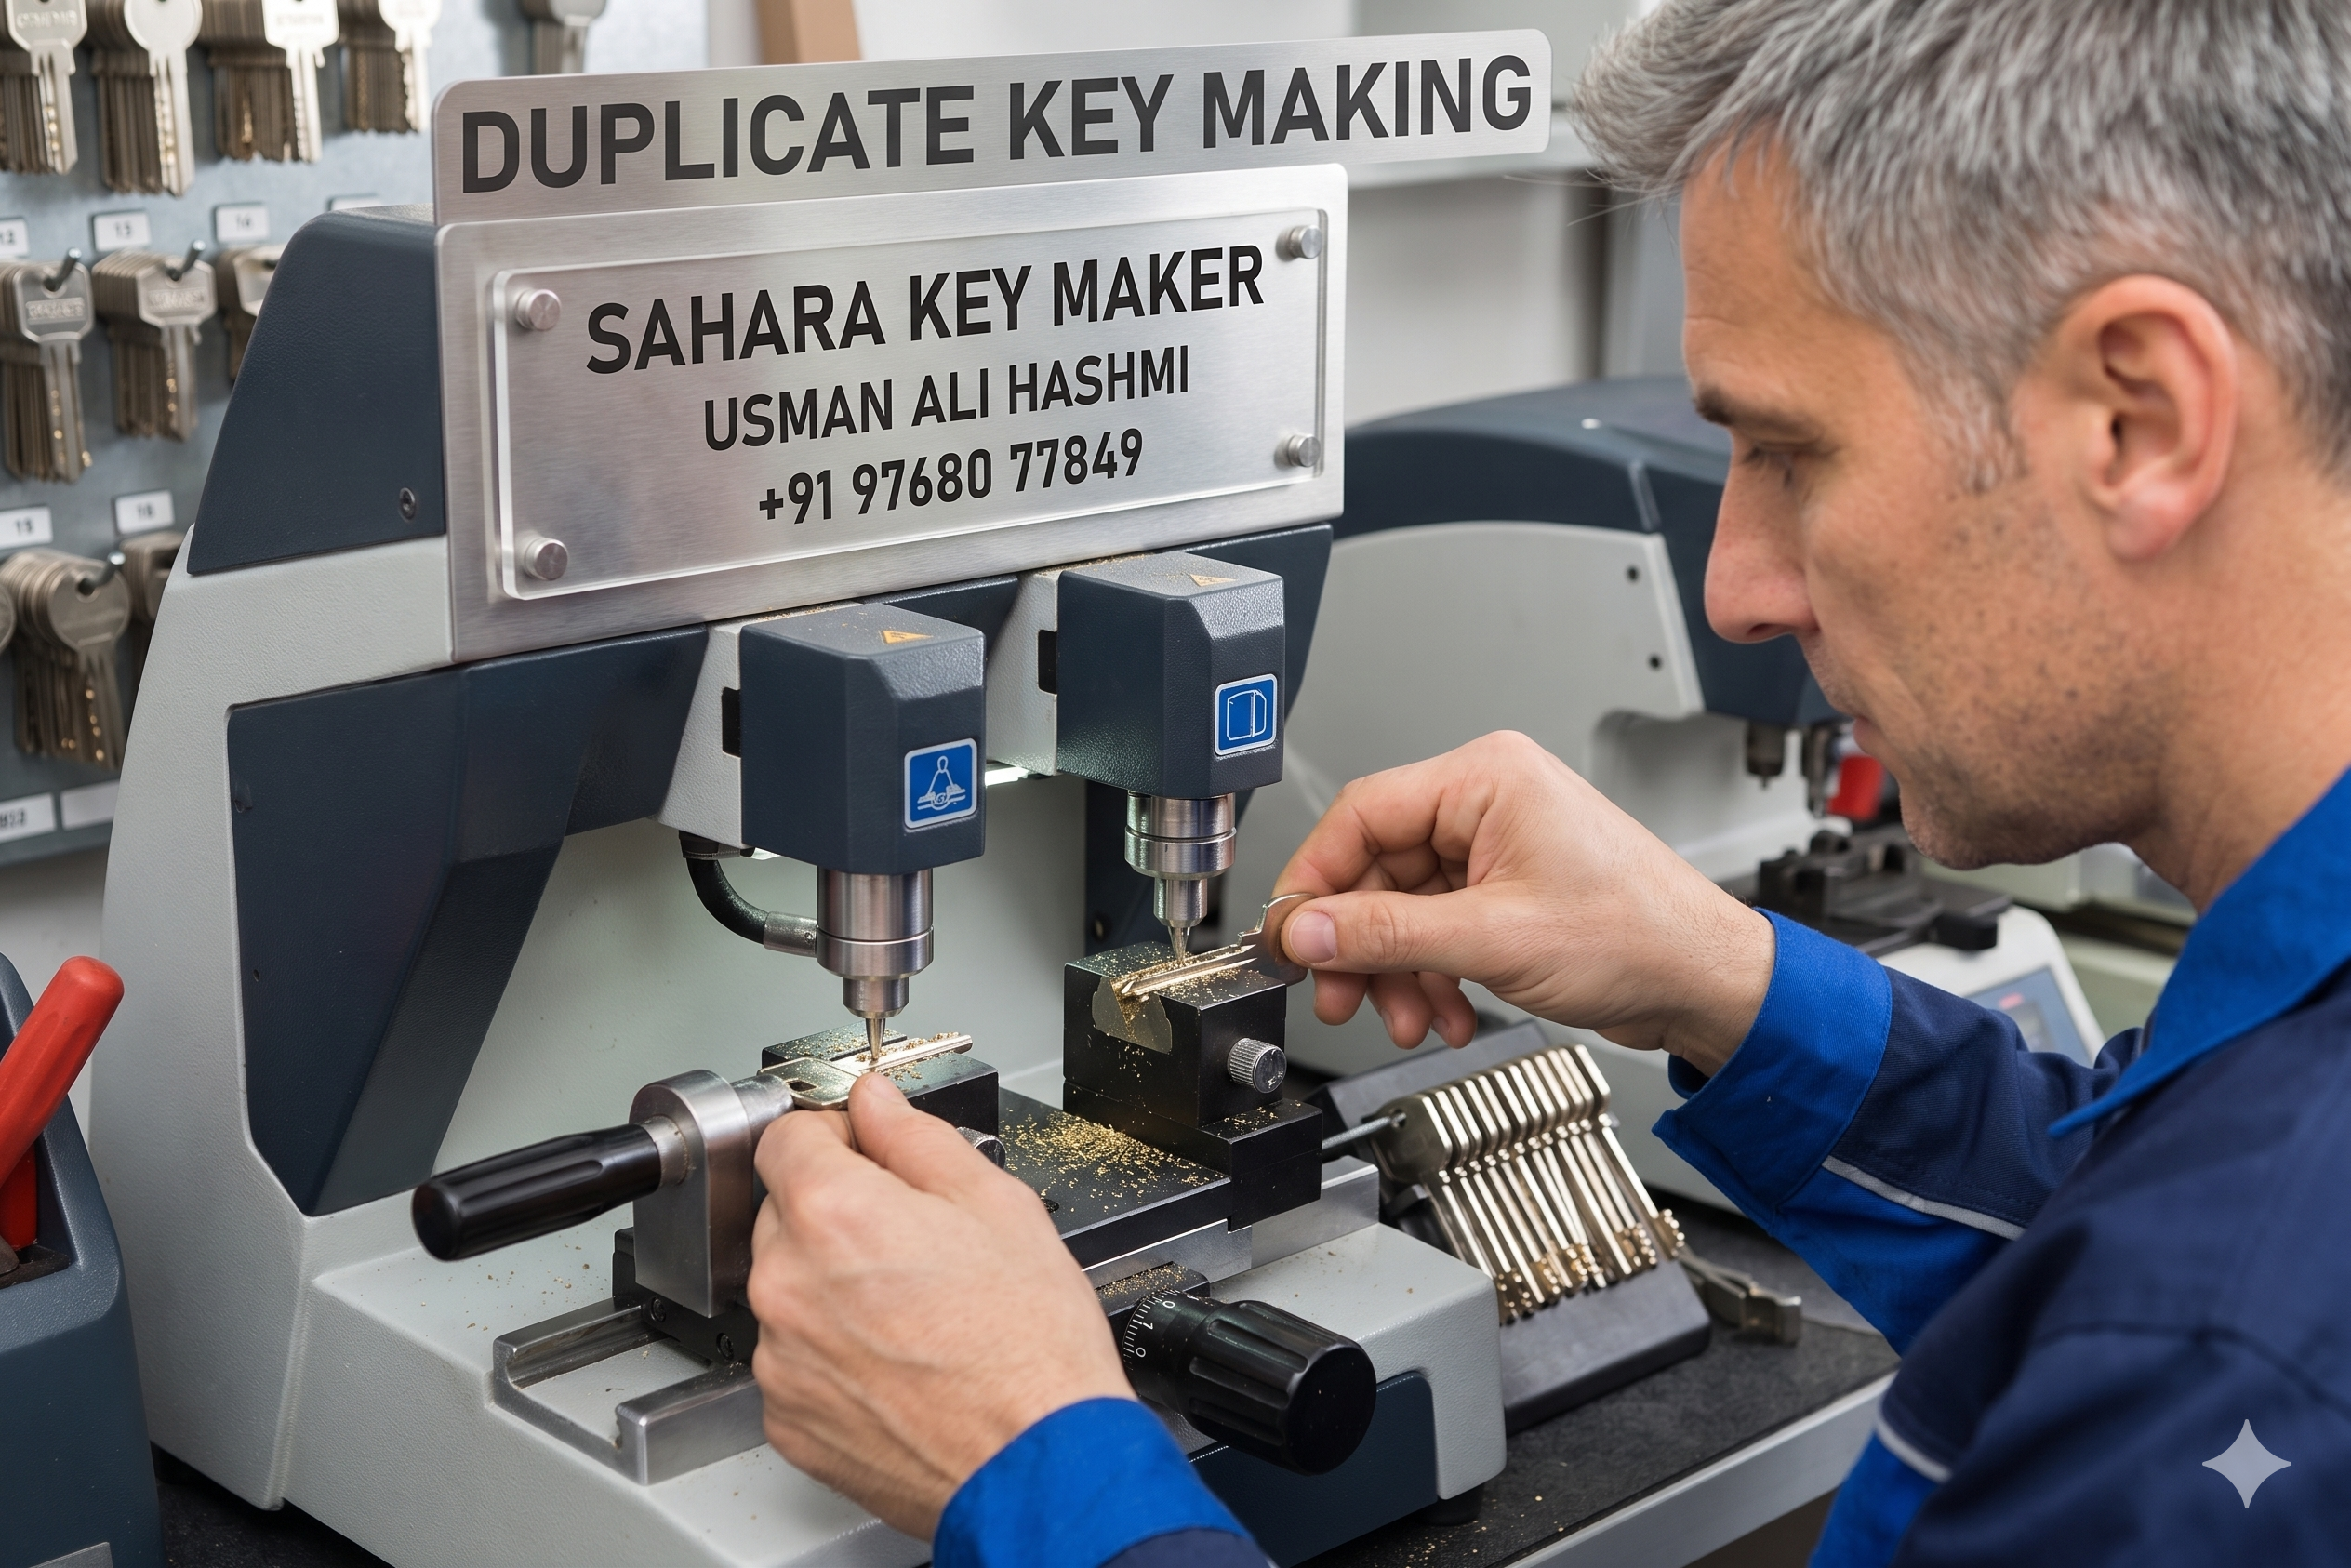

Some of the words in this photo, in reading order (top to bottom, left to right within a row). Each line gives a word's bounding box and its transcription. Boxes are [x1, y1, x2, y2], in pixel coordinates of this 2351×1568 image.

[462, 85, 975, 194] DUPLICATE
[1009, 73, 1175, 161] KEY
[1203, 55, 1531, 149] MAKING
[586, 280, 886, 375] SAHARA
[910, 265, 1032, 342] KEY
[1053, 245, 1265, 326] MAKER
[704, 379, 893, 451] USMAN
[910, 367, 989, 427] ALI
[1008, 345, 1189, 415] HASHMI
[759, 469, 832, 525] +91
[852, 448, 992, 515] 97680
[1010, 428, 1143, 493] 77849
